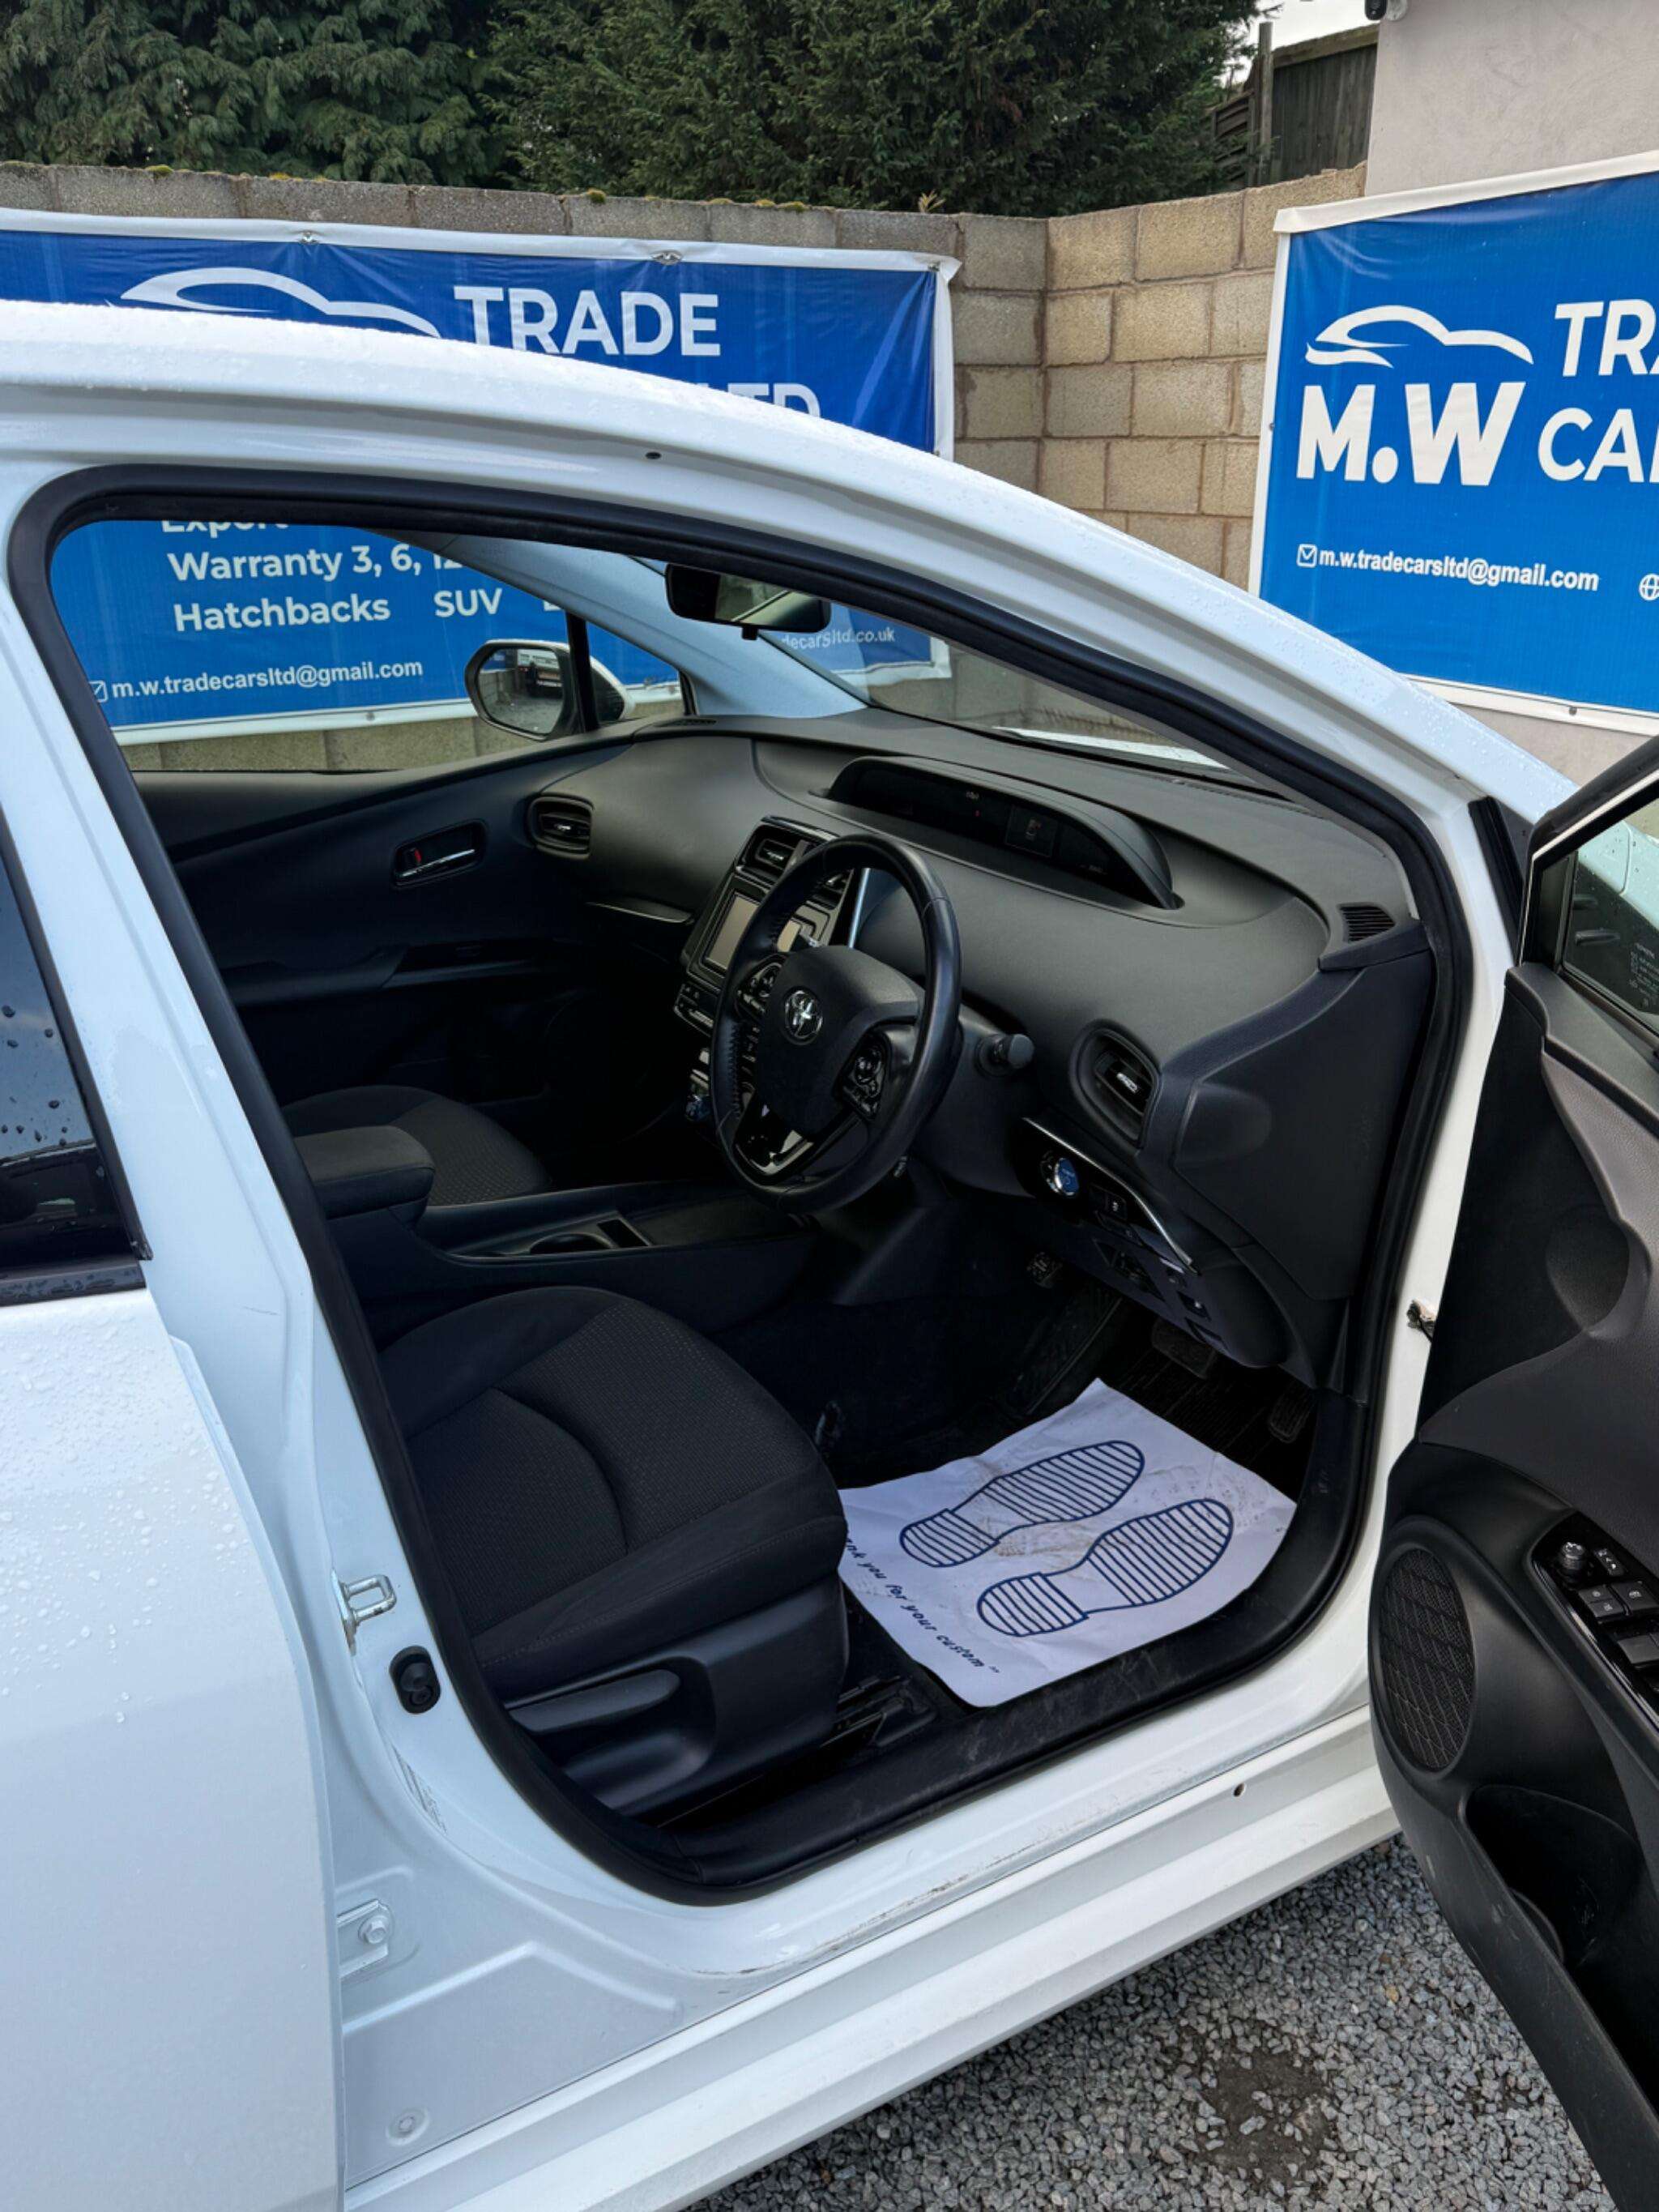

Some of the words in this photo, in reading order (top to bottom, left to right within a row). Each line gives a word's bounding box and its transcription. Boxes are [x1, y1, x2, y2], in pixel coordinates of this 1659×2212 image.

[454, 286, 721, 357] TRADE
[1555, 298, 1659, 377] TR
[1296, 381, 1526, 486] M.W
[1537, 407, 1659, 483] CA
[167, 550, 343, 582] Warranty
[352, 544, 382, 578] 3,
[390, 544, 421, 576] 6,
[1319, 549, 1600, 591] m.w.tradecarsltd@gmail.com
[173, 593, 390, 631] Hatchbacks
[433, 587, 502, 617] SUV
[112, 660, 424, 698] m.w.tradecarsltd@gmail.com
[857, 1563, 887, 1579] you
[885, 1584, 907, 1600] for
[900, 1605, 937, 1631] your
